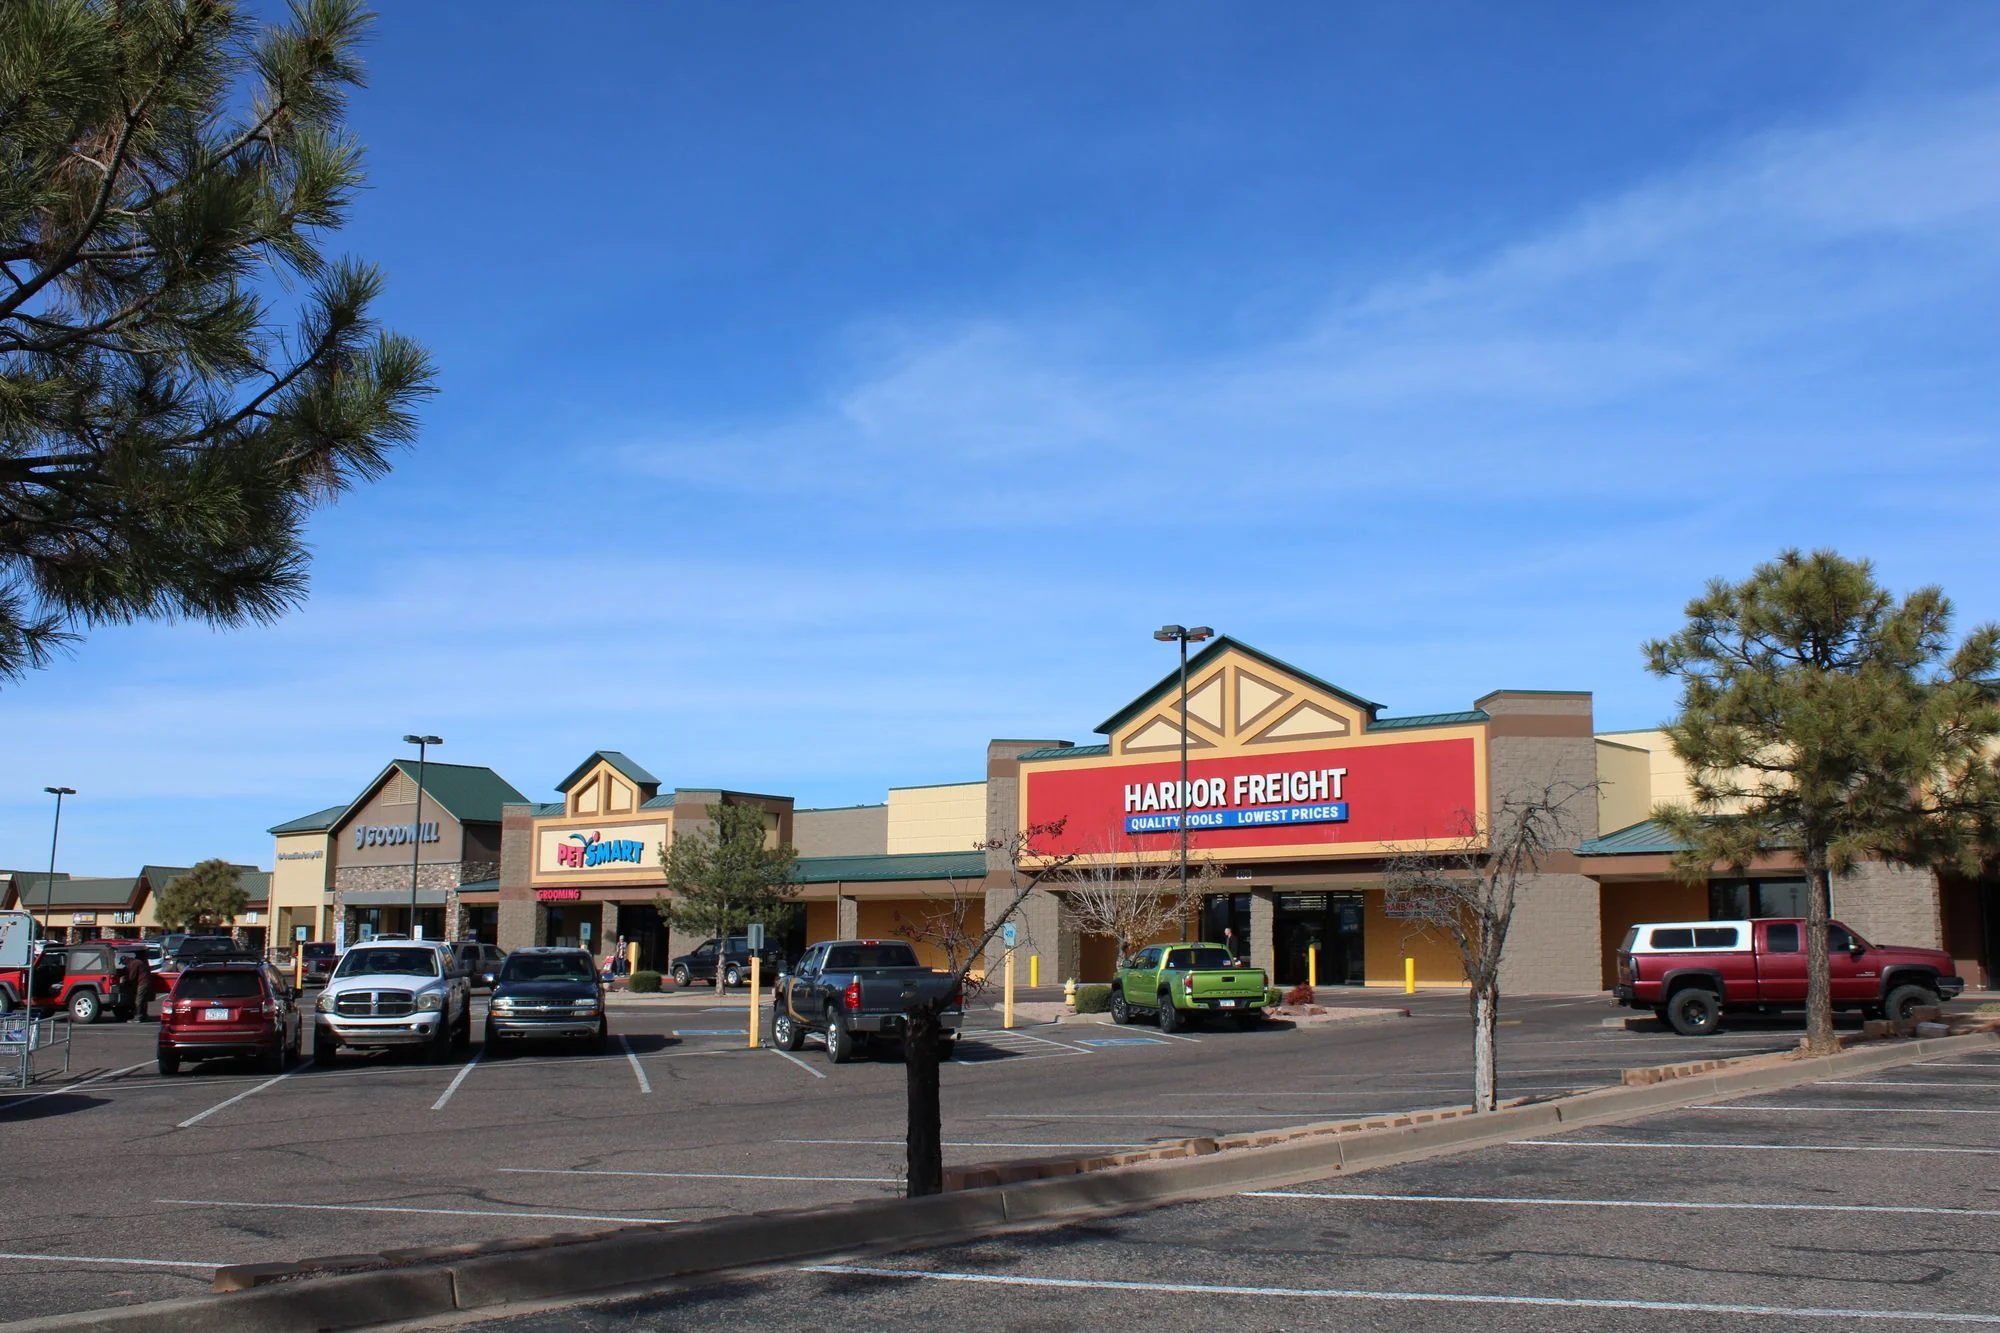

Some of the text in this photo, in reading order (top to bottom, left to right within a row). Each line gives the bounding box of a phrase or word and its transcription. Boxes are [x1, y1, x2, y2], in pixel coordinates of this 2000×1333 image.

[1125, 768, 1347, 812] HARBOR FREIGHT
[1131, 806, 1339, 829] QUALITY TOOLS LOWEST PRICES
[537, 889, 581, 901] GROOMING
